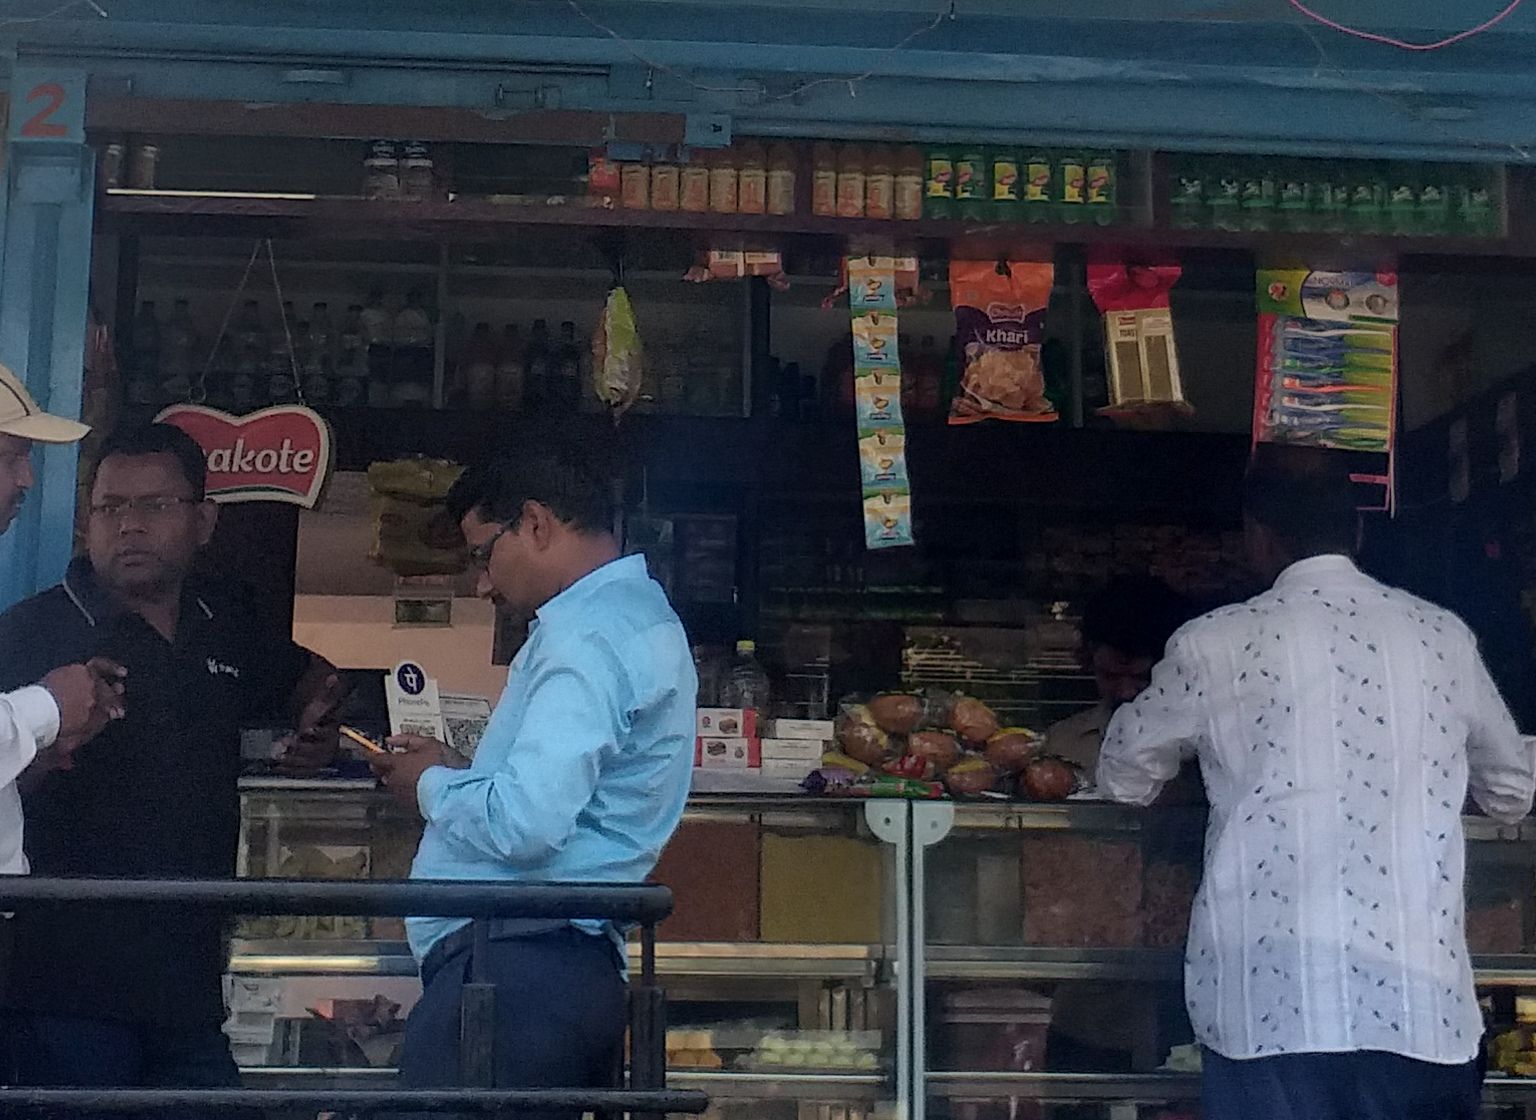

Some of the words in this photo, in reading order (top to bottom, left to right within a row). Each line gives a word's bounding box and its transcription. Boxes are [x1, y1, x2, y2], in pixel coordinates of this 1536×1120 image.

[20, 83, 68, 138] 2
[985, 329, 1029, 345] Khari
[207, 437, 314, 474] akote
